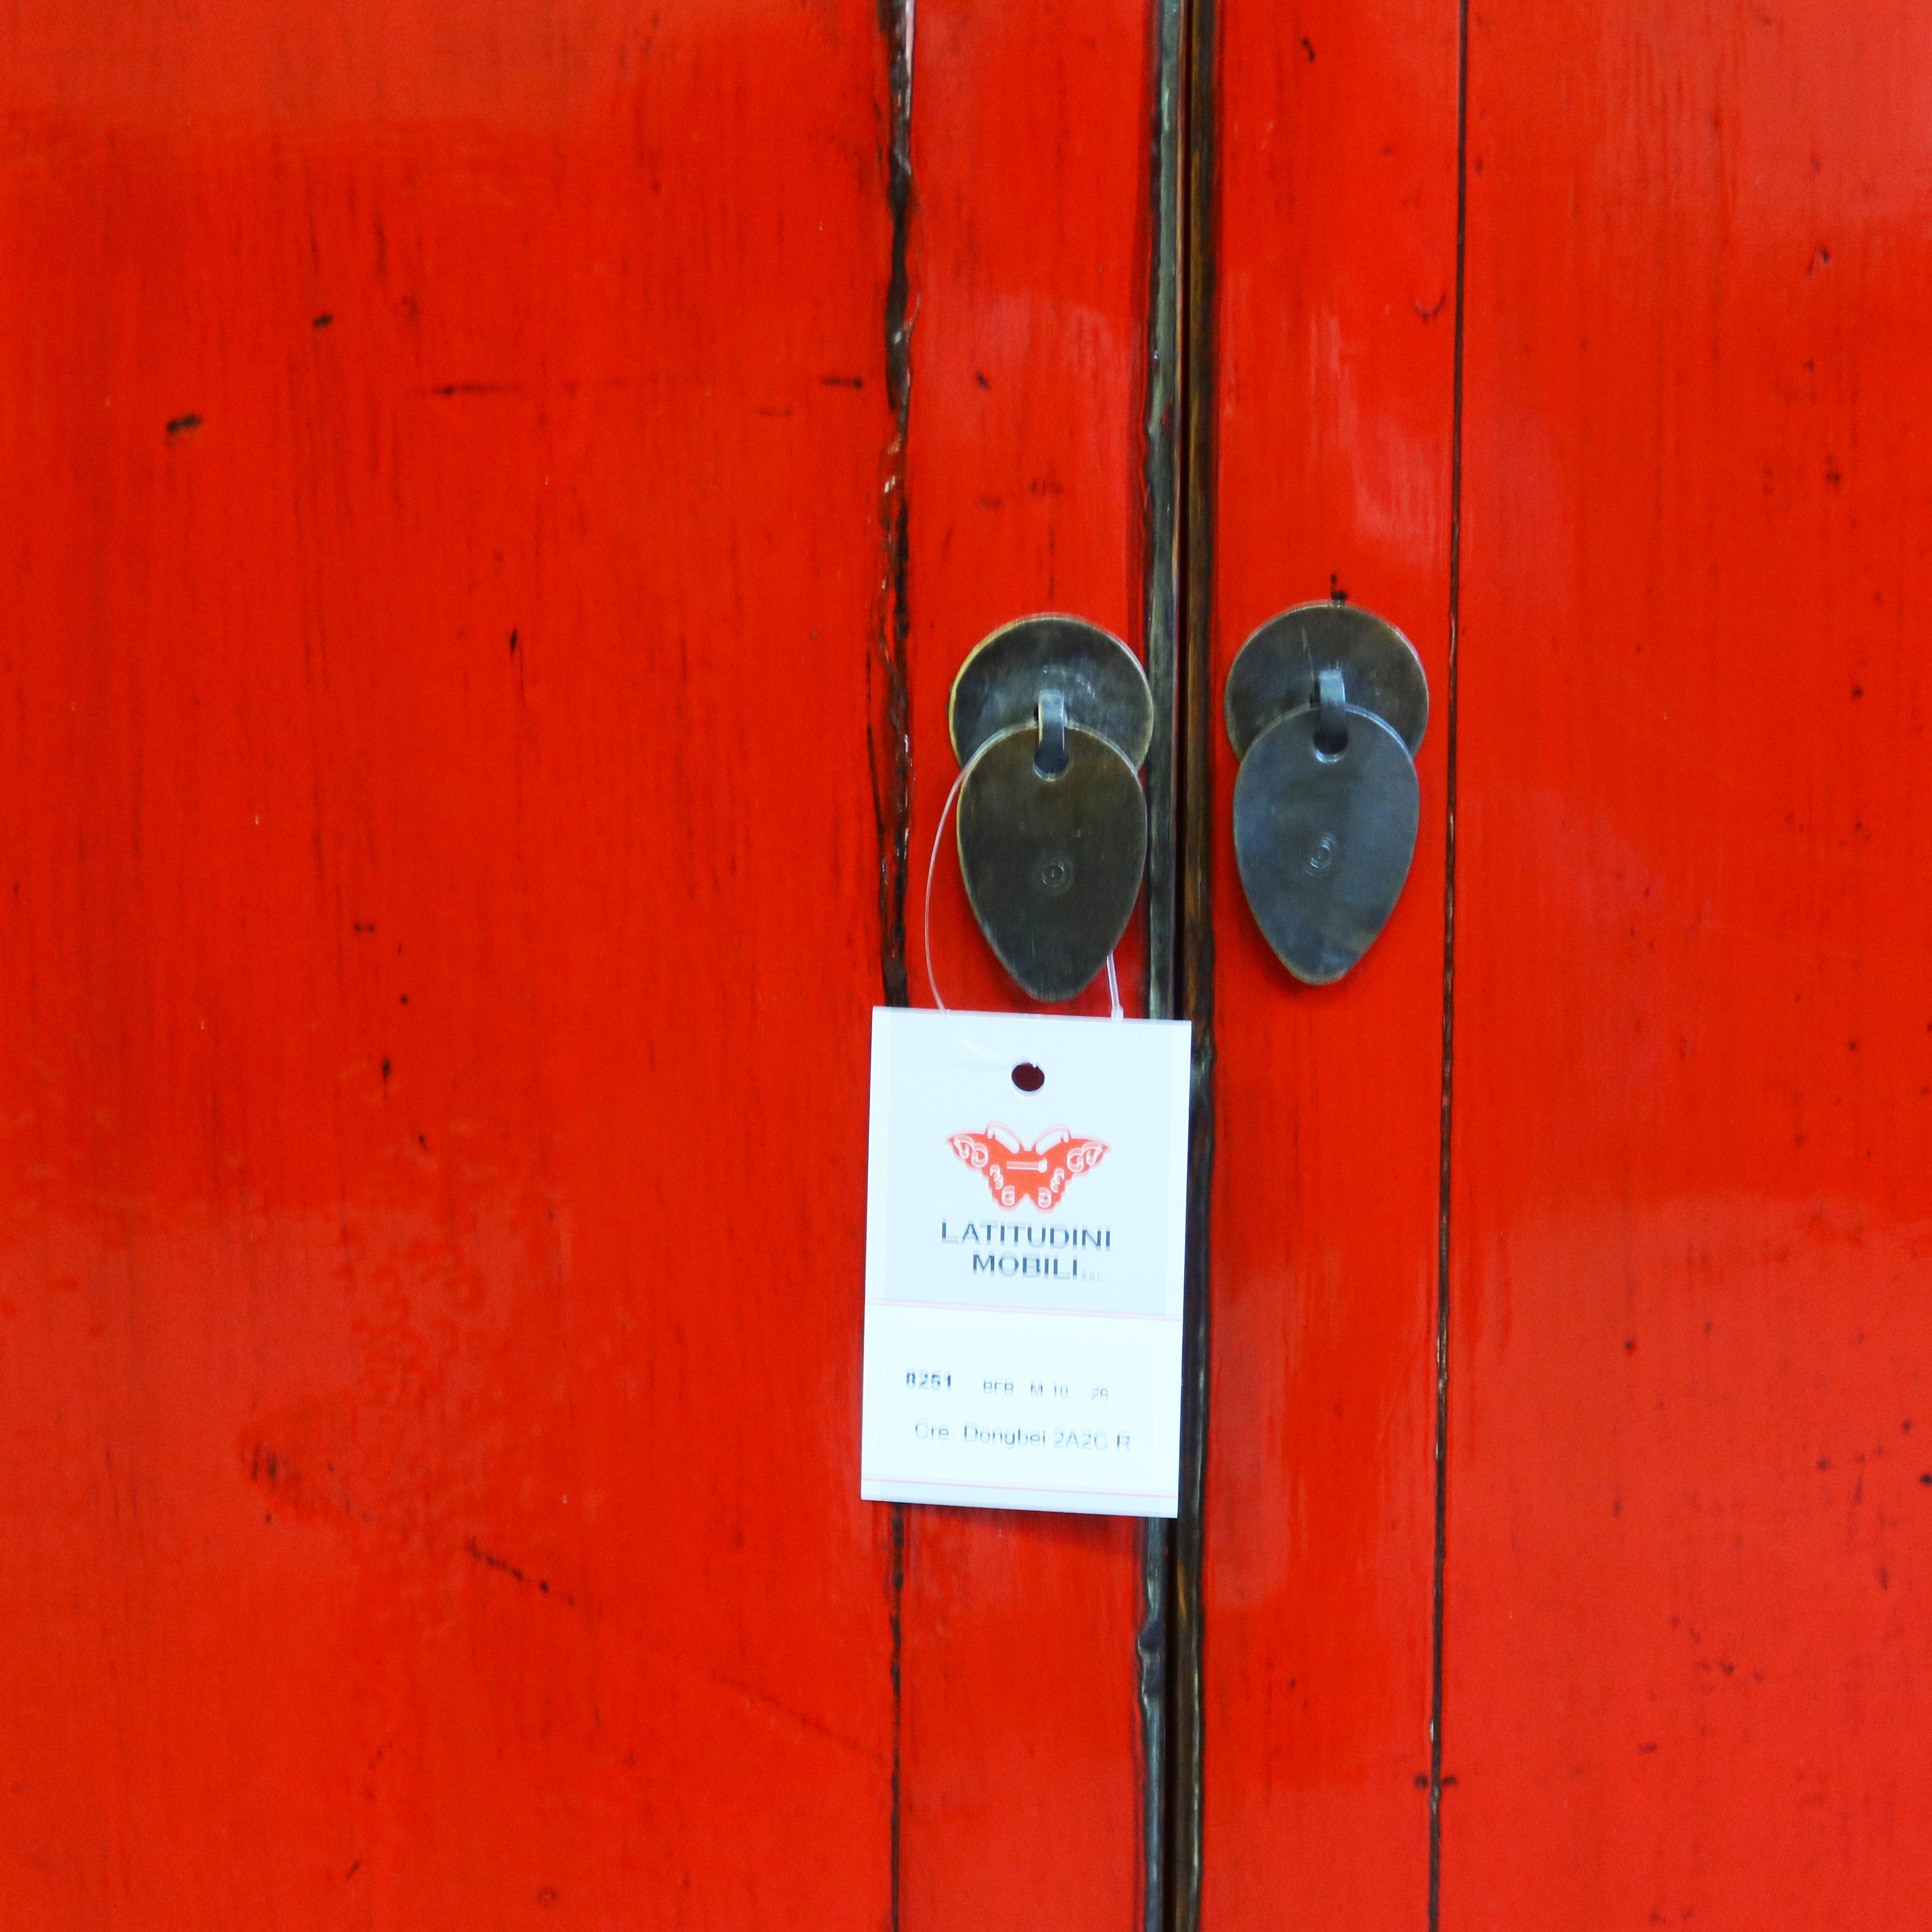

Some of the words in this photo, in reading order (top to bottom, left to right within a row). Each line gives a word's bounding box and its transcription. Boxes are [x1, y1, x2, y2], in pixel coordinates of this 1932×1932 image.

[941, 1219, 1111, 1251] LATITUDINI
[972, 1251, 1078, 1281] MOBILI
[1030, 1380, 1043, 1398] M
[964, 1421, 1046, 1450] Dongbei
[1116, 1430, 1131, 1453] R
